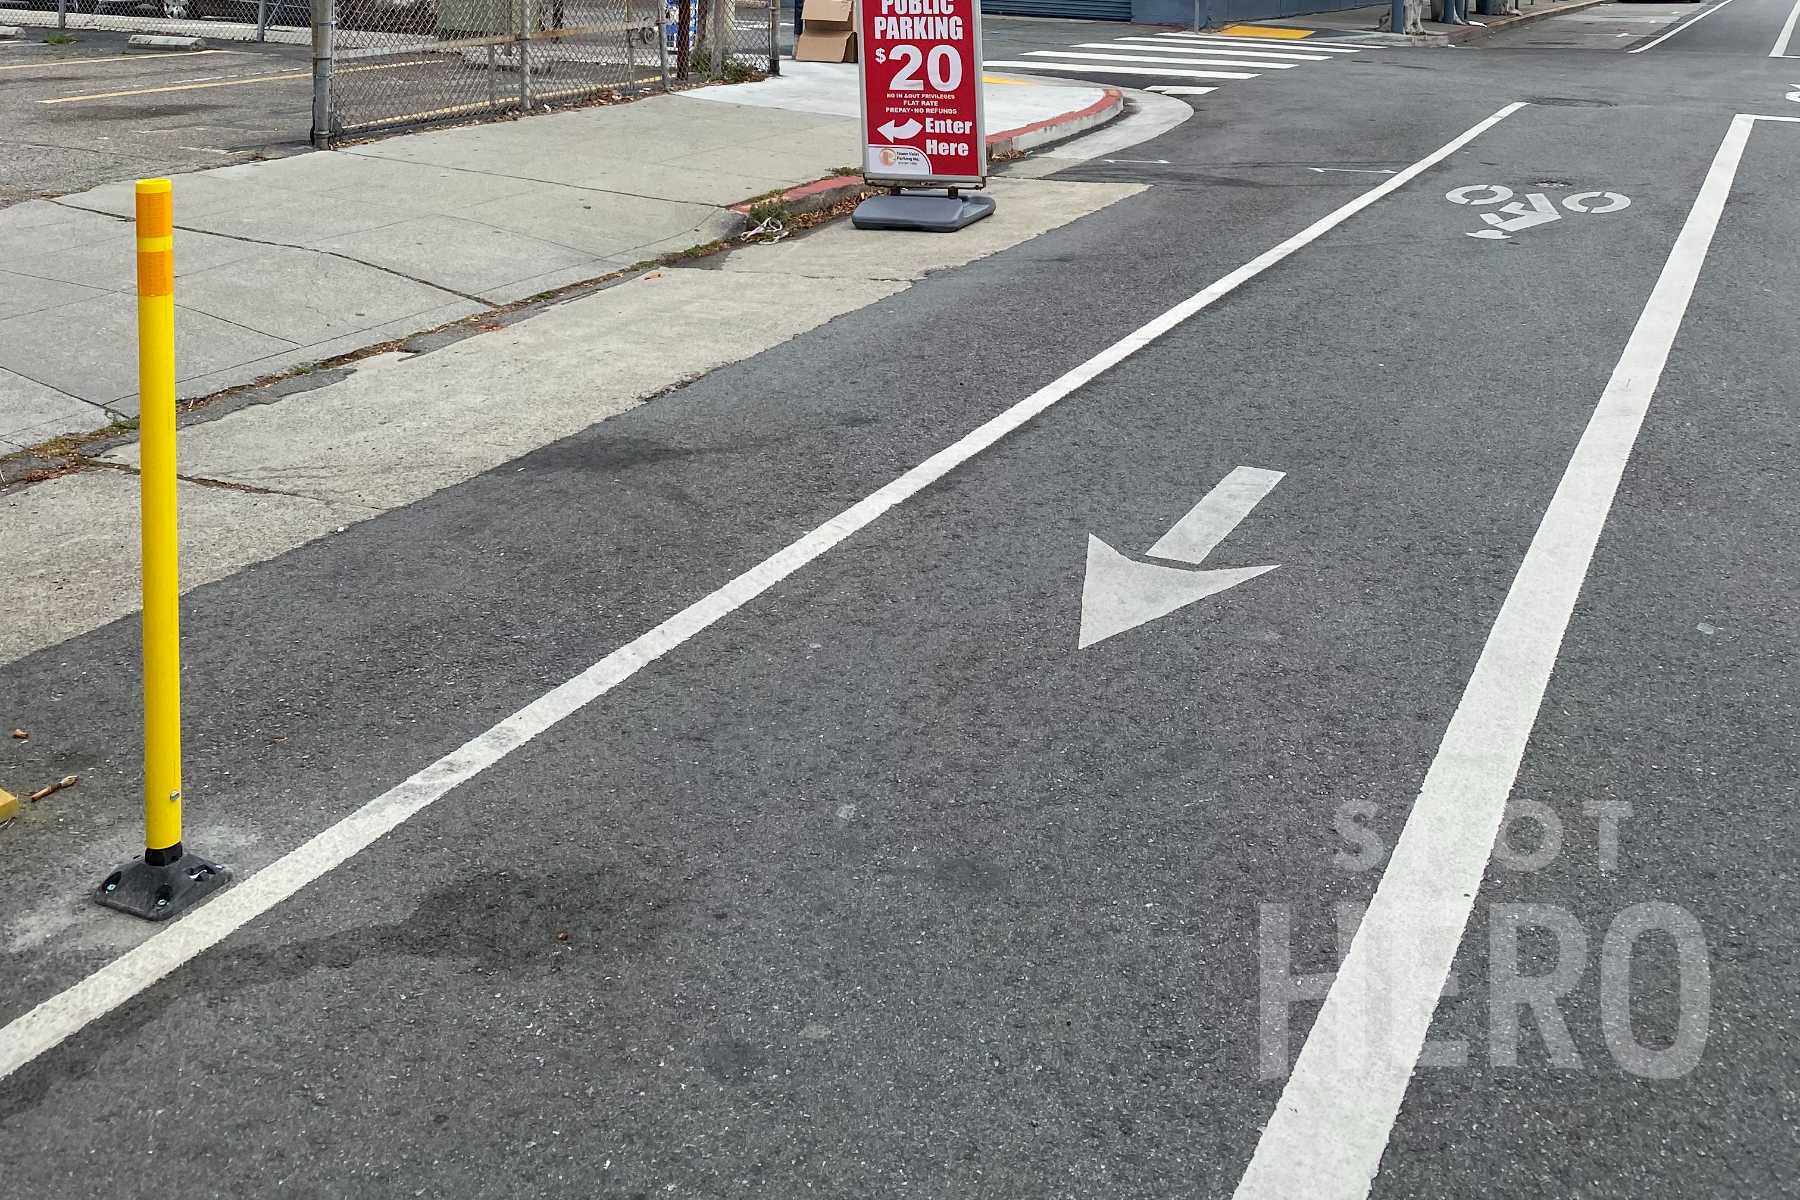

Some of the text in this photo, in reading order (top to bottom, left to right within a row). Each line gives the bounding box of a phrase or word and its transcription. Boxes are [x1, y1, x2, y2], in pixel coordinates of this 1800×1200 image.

[874, 16, 964, 40] PARKING
[874, 43, 963, 93] $20
[925, 117, 973, 135] Enter
[925, 139, 969, 156] Here
